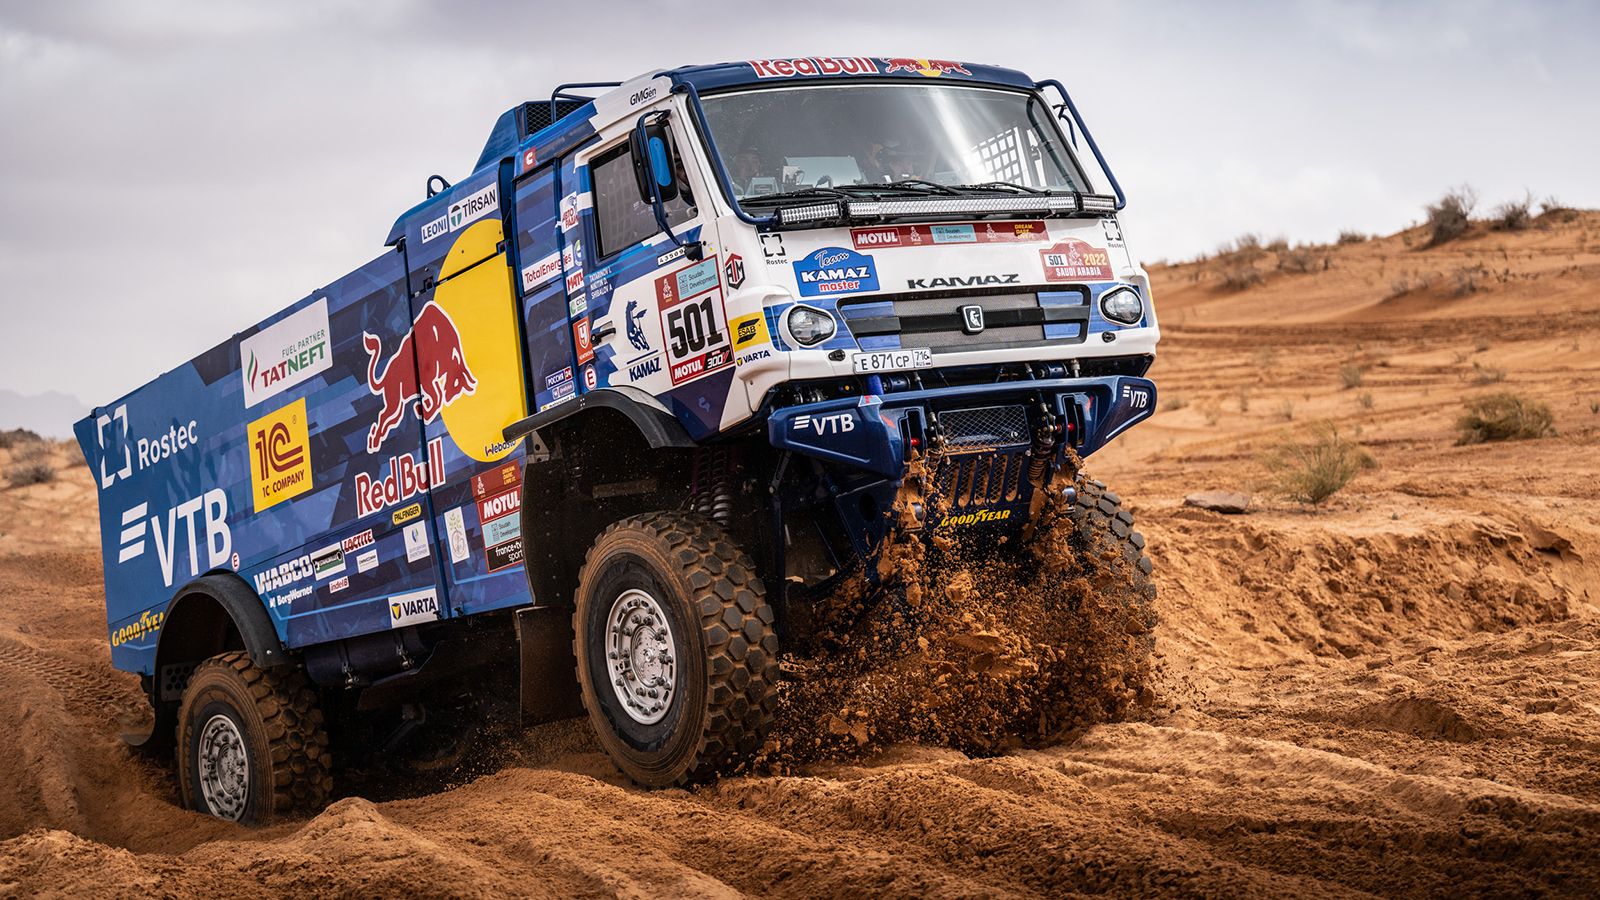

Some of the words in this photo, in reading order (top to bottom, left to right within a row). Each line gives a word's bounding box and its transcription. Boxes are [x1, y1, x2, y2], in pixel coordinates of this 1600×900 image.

[751, 57, 819, 78] Red
[814, 57, 879, 75] Bull
[422, 218, 447, 240] LEONI
[857, 231, 898, 244] MOTUL
[815, 250, 849, 268] Team
[1048, 254, 1064, 266] 501
[1083, 253, 1107, 266] 2022
[689, 274, 716, 289] Development
[801, 266, 870, 283] KAMAZ
[907, 273, 1020, 289] KAMAZ
[1056, 266, 1077, 277] SAUDI
[1077, 266, 1101, 276] ARABIA
[819, 280, 860, 293] master
[667, 297, 723, 358] 501
[737, 324, 756, 337] ESAB
[281, 344, 297, 358] FUEL
[297, 329, 326, 348] PARTNER
[261, 341, 326, 388] TATNEFT
[707, 350, 730, 369] 300V
[743, 350, 771, 363] VARTA
[914, 351, 929, 361] 716
[586, 371, 595, 386] E
[629, 357, 662, 382] KAMAZ
[674, 359, 703, 380] MOTUL
[1130, 390, 1148, 408] VTB
[812, 413, 855, 435] VTB
[137, 420, 199, 470] Rostec
[262, 485, 270, 498] 1C
[272, 469, 305, 493] COMPANY
[355, 456, 400, 519] Red
[398, 436, 446, 501] Bull
[394, 505, 420, 522] PALFINGER
[484, 490, 520, 519] MOTUL
[941, 509, 1011, 527] GOODYEAR
[150, 488, 232, 588] VTB
[343, 531, 373, 553] LOCTITE
[253, 554, 314, 596] WABCO
[277, 585, 313, 606] BorgWarner
[402, 596, 436, 617] VARTA
